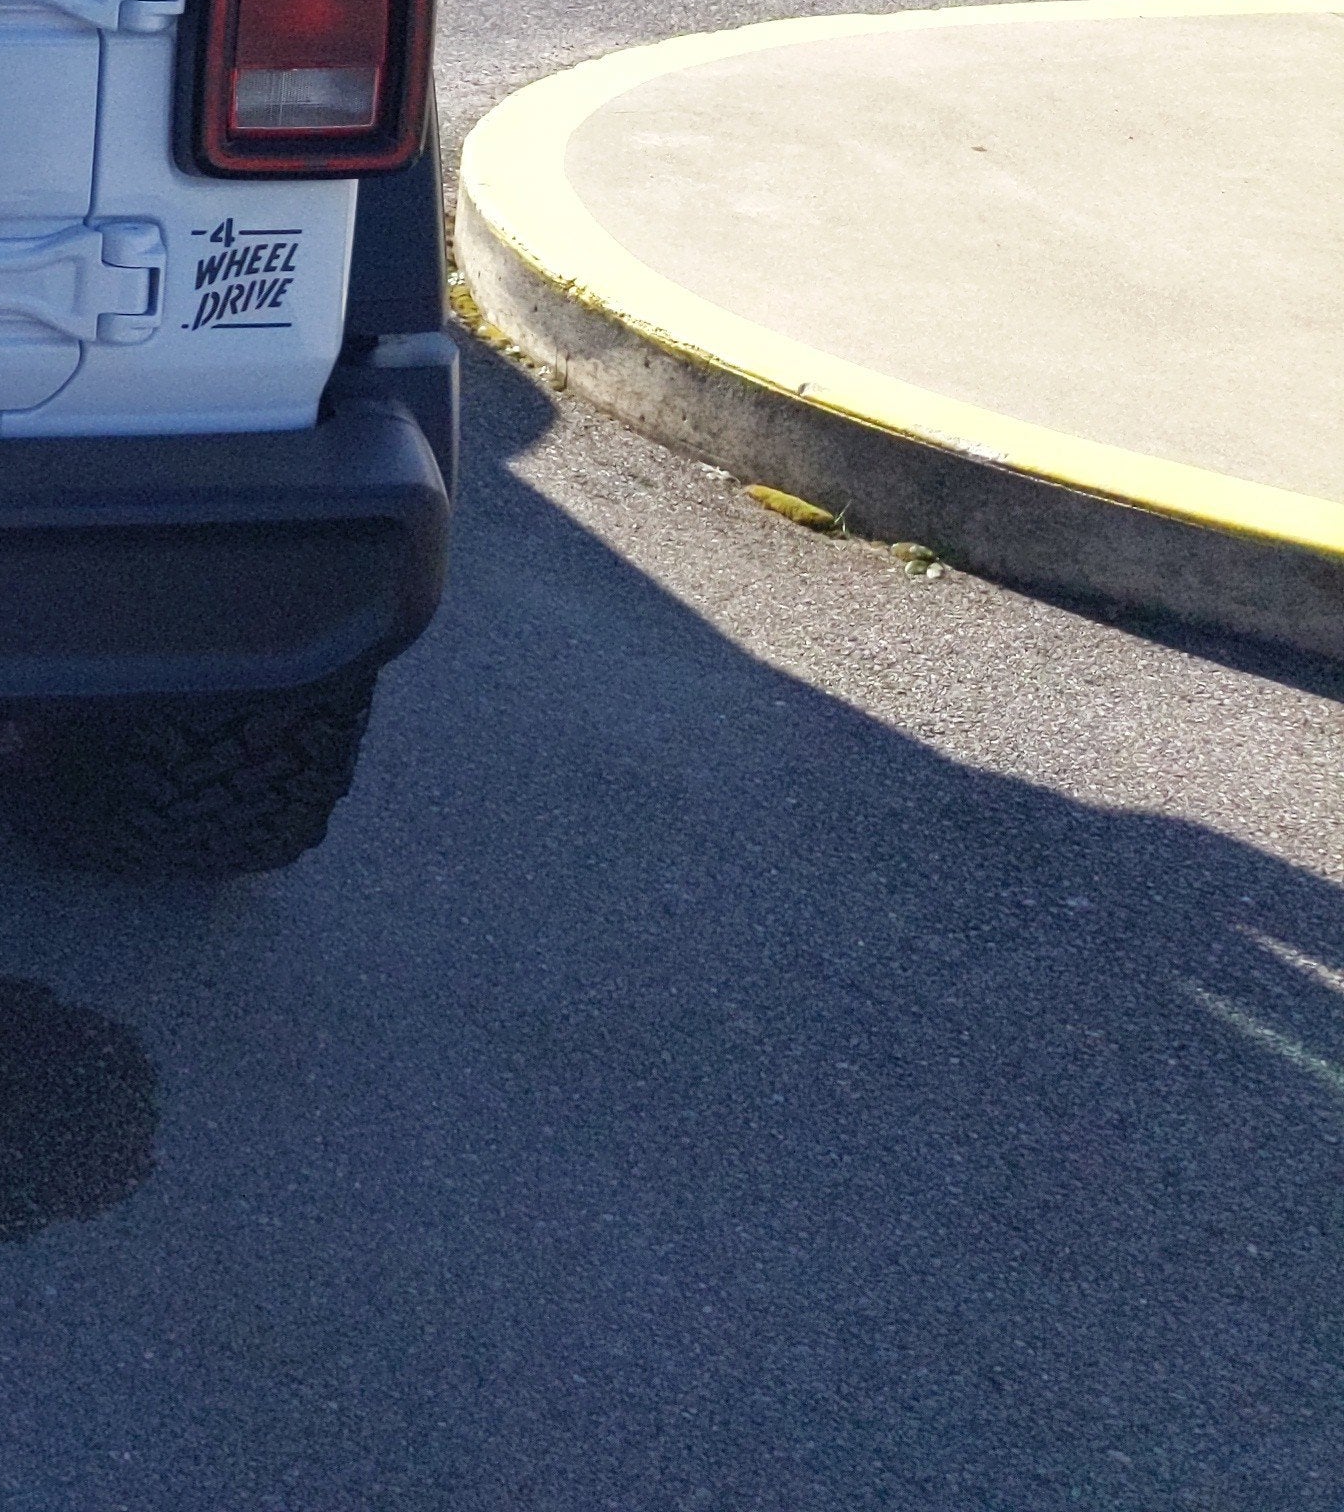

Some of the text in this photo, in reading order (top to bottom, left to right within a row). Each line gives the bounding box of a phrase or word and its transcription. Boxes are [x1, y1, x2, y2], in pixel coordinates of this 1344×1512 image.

[210, 218, 236, 247] 4
[195, 243, 299, 290] WHEEL
[192, 278, 294, 331] DRIVE
